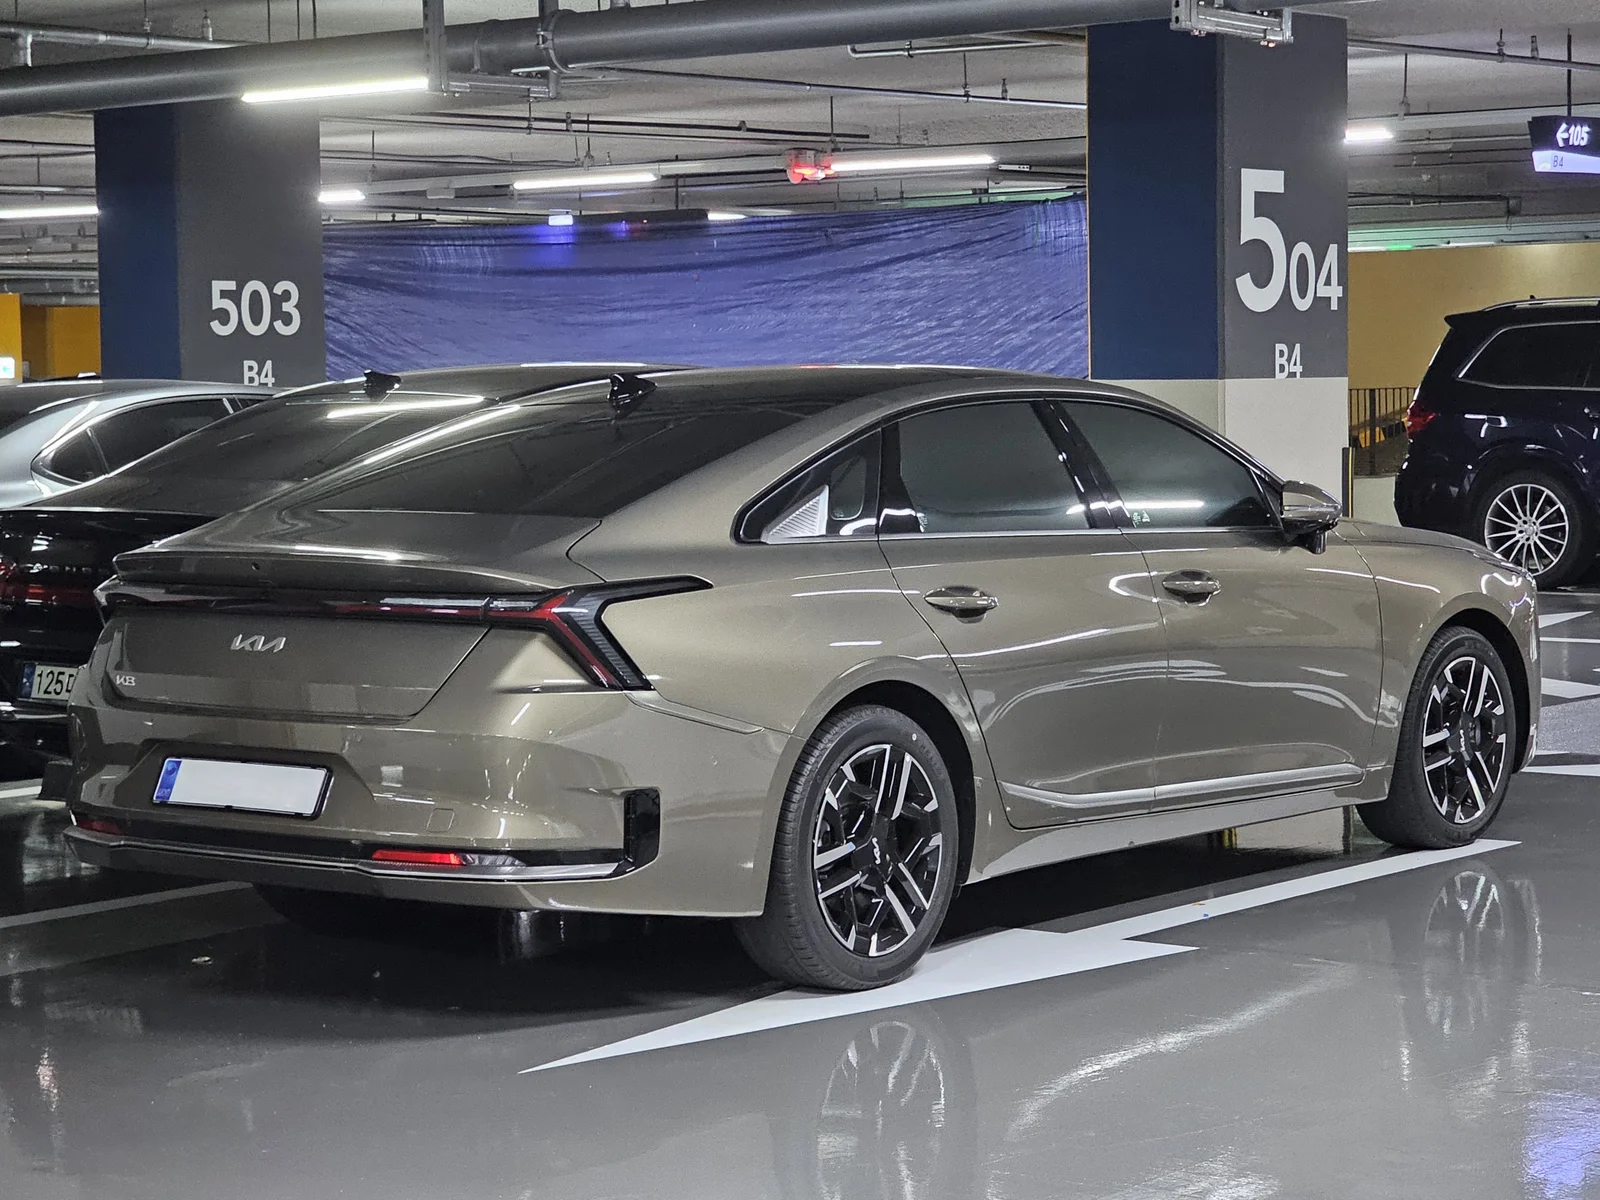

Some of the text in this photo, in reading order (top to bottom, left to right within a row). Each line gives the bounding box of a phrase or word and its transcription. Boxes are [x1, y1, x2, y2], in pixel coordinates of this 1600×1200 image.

[1569, 124, 1591, 146] 105
[1235, 168, 1343, 312] 504
[210, 280, 301, 336] 503
[243, 360, 275, 387] B4
[1275, 343, 1303, 379] B4
[230, 633, 287, 653] KIA
